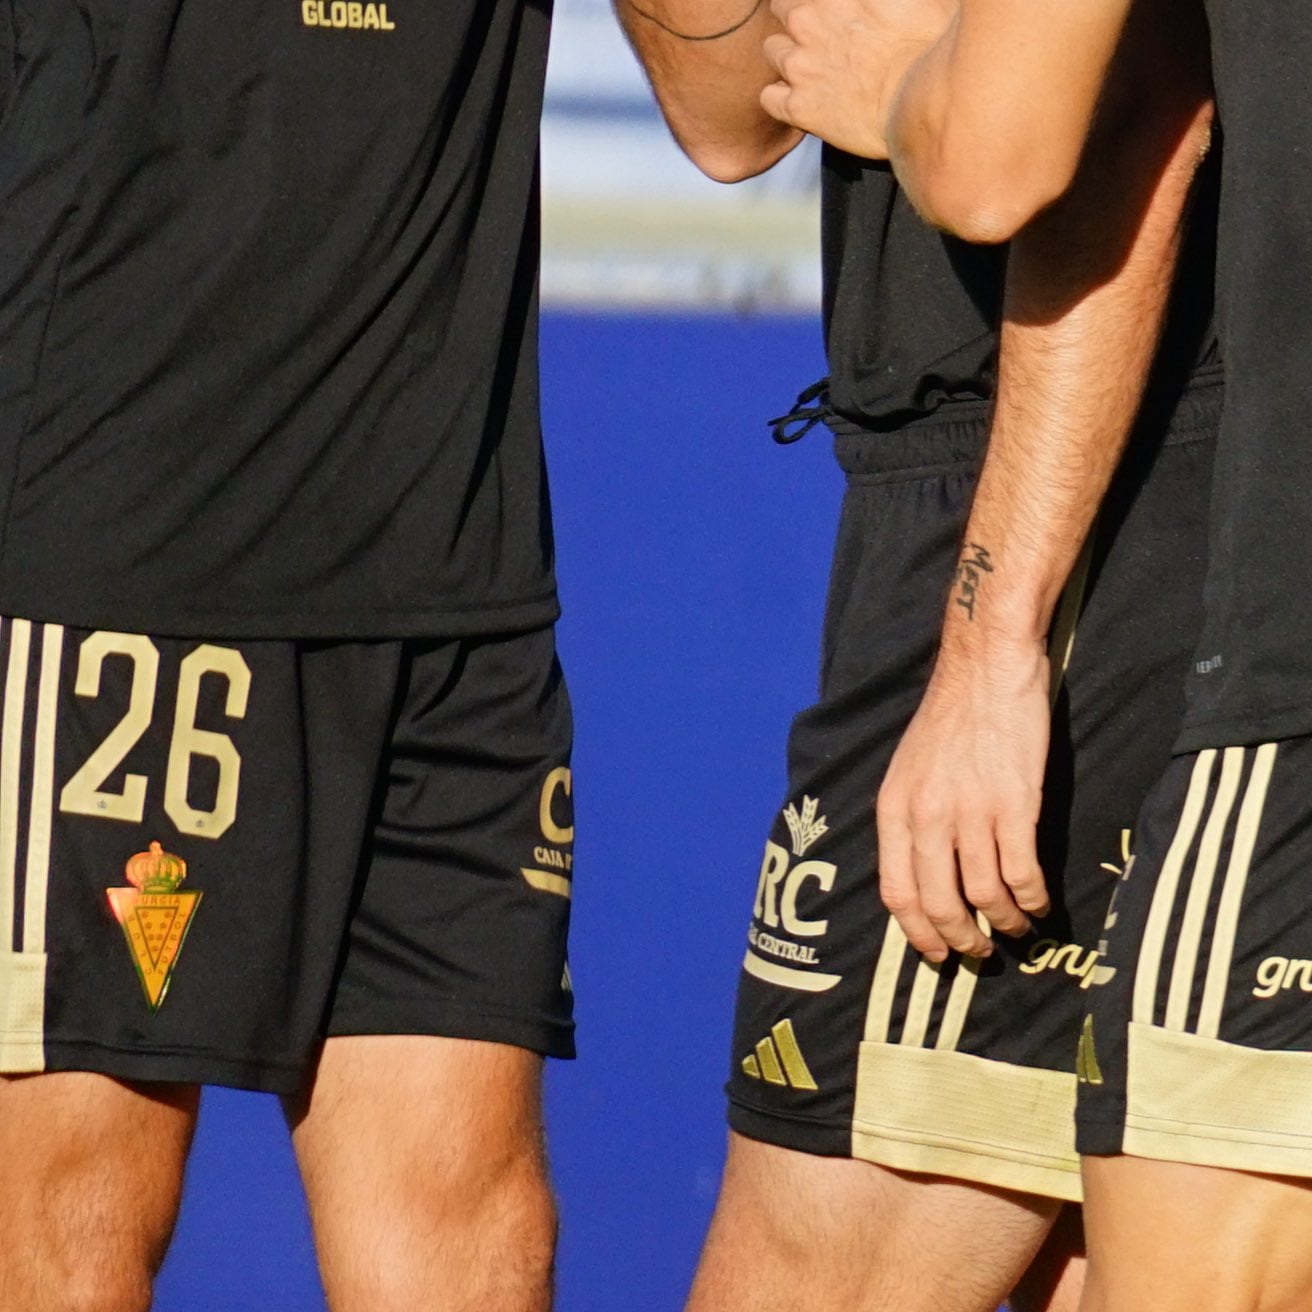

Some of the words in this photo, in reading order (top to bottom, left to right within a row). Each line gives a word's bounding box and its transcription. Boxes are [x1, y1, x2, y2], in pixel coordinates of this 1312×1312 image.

[302, 0, 396, 30] GLOBAL
[59, 630, 252, 839] 26
[757, 932, 821, 964] CENTRAL
